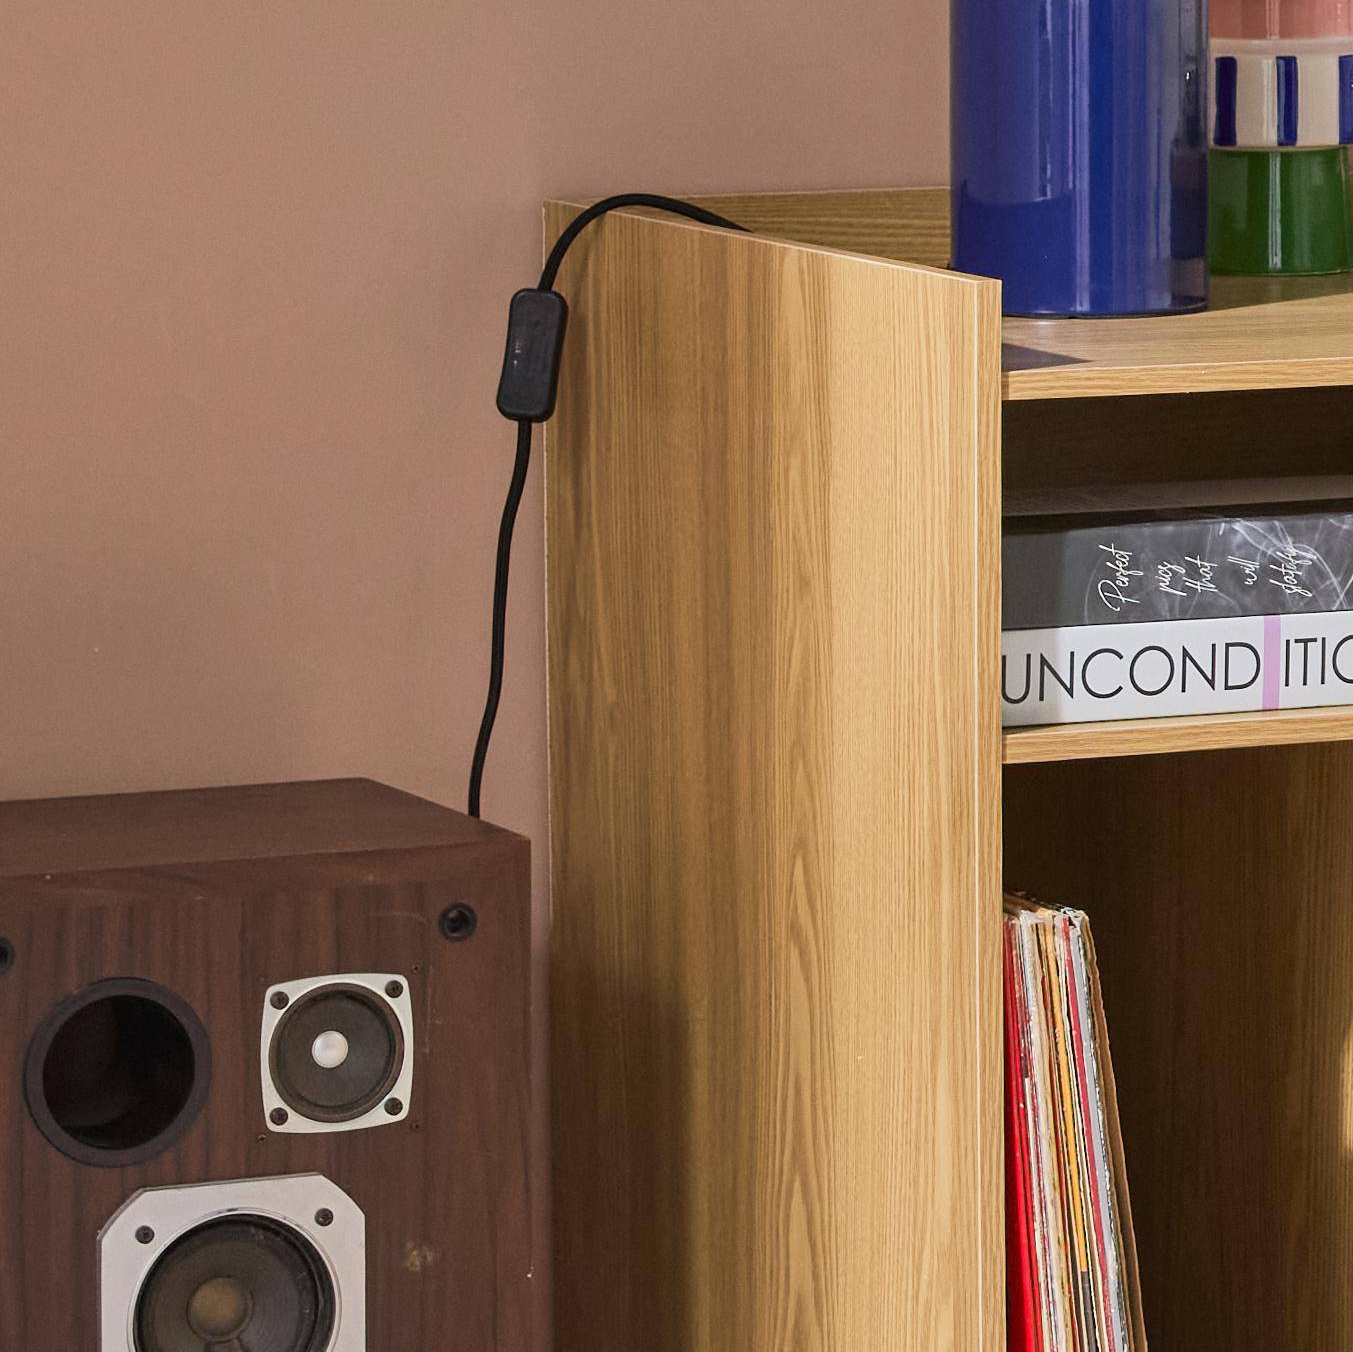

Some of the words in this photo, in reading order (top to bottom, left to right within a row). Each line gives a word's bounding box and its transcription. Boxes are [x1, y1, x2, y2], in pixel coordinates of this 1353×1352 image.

[1098, 543, 1144, 612] Perfect
[1155, 561, 1187, 596] pics
[1182, 555, 1218, 592] that
[1228, 556, 1260, 585] will
